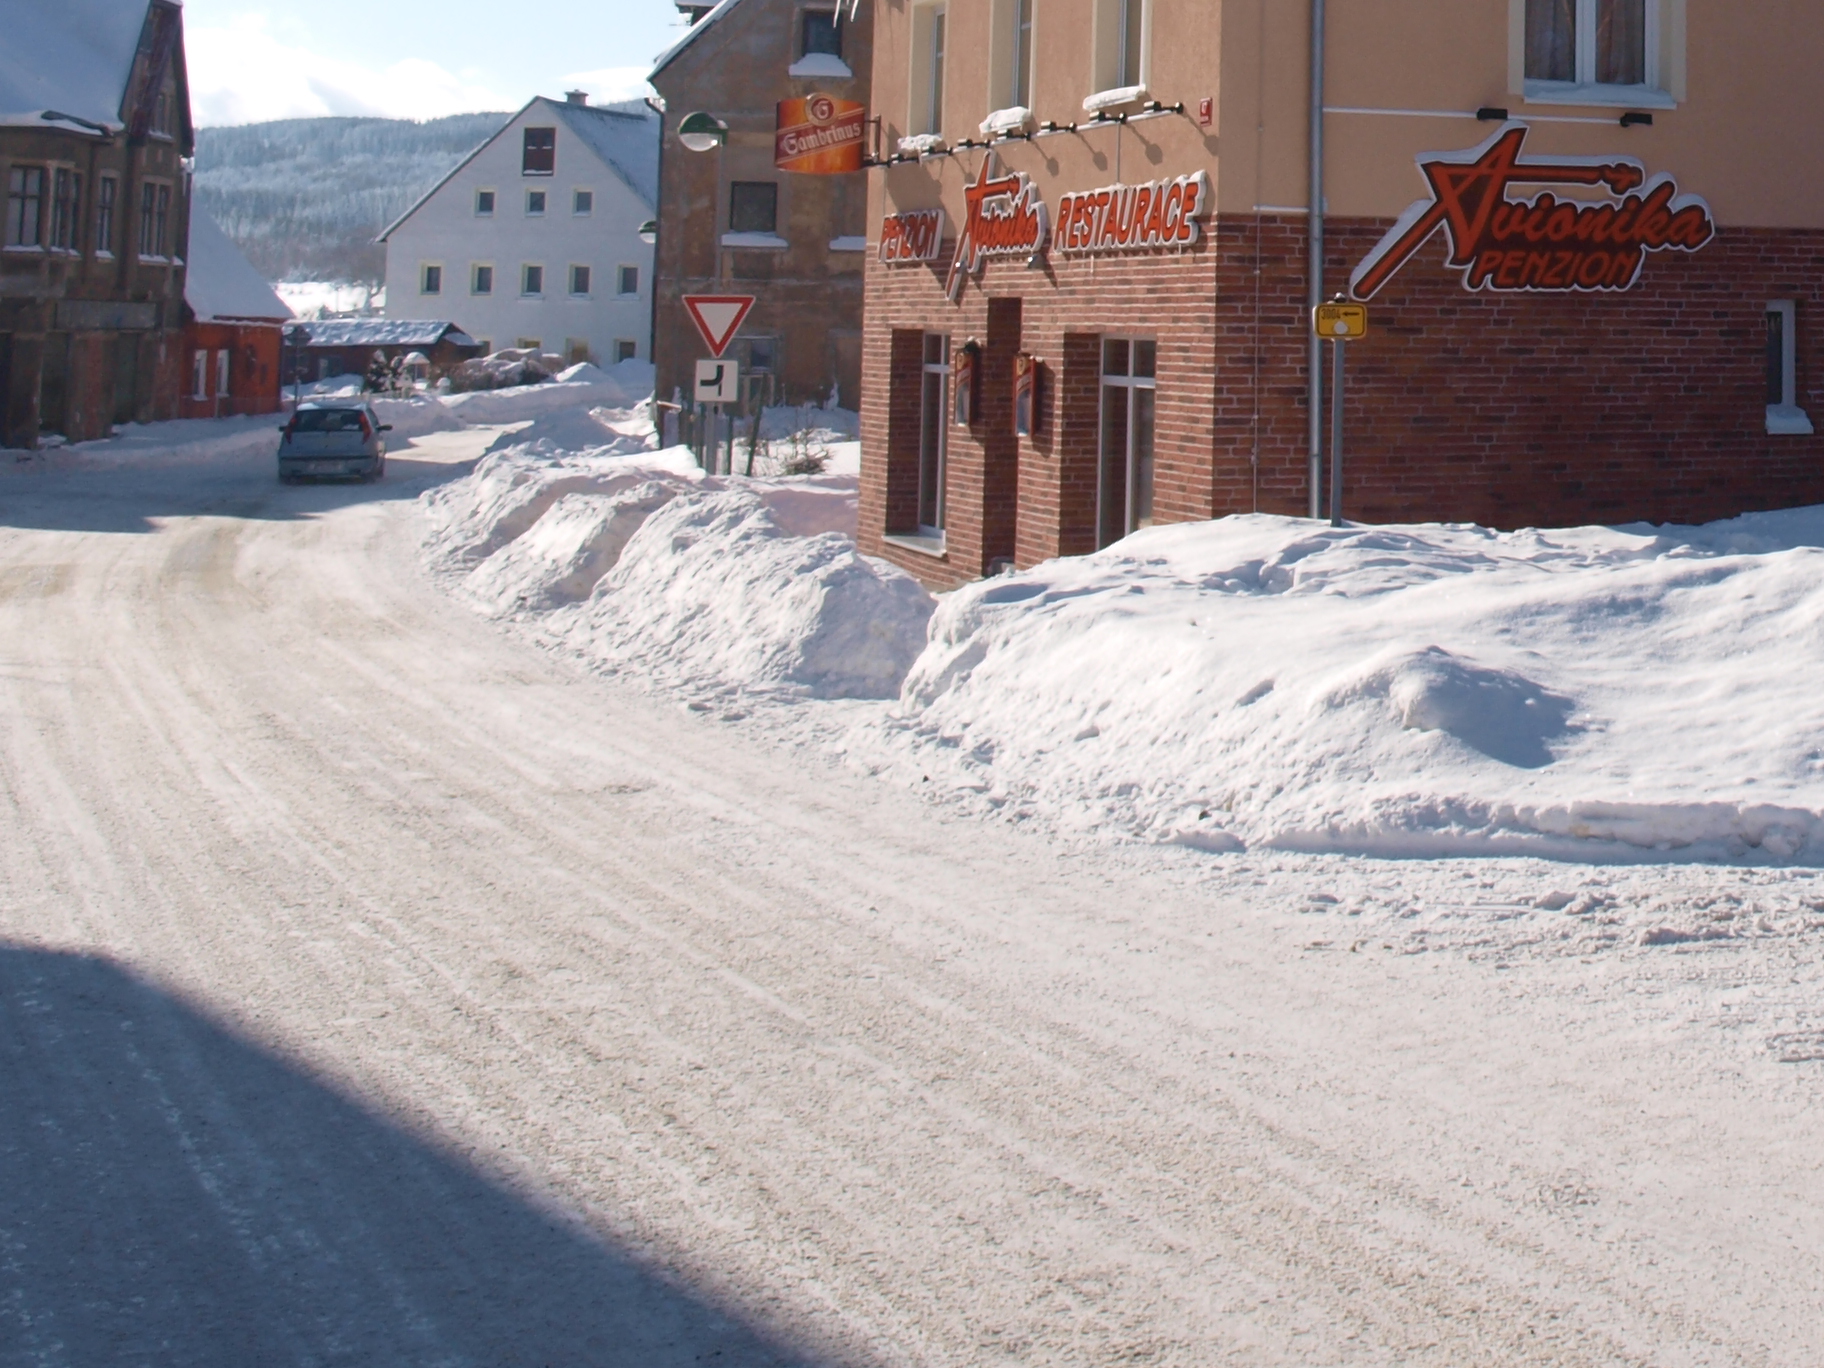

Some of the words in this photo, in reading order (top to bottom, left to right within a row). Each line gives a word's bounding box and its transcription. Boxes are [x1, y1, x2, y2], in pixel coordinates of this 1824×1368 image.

[783, 122, 861, 155] Gambrinus
[879, 213, 939, 259] PENZION
[1053, 182, 1199, 251] RESTAURACE
[1354, 128, 1711, 297] Avionika
[1472, 249, 1640, 287] PENZION
